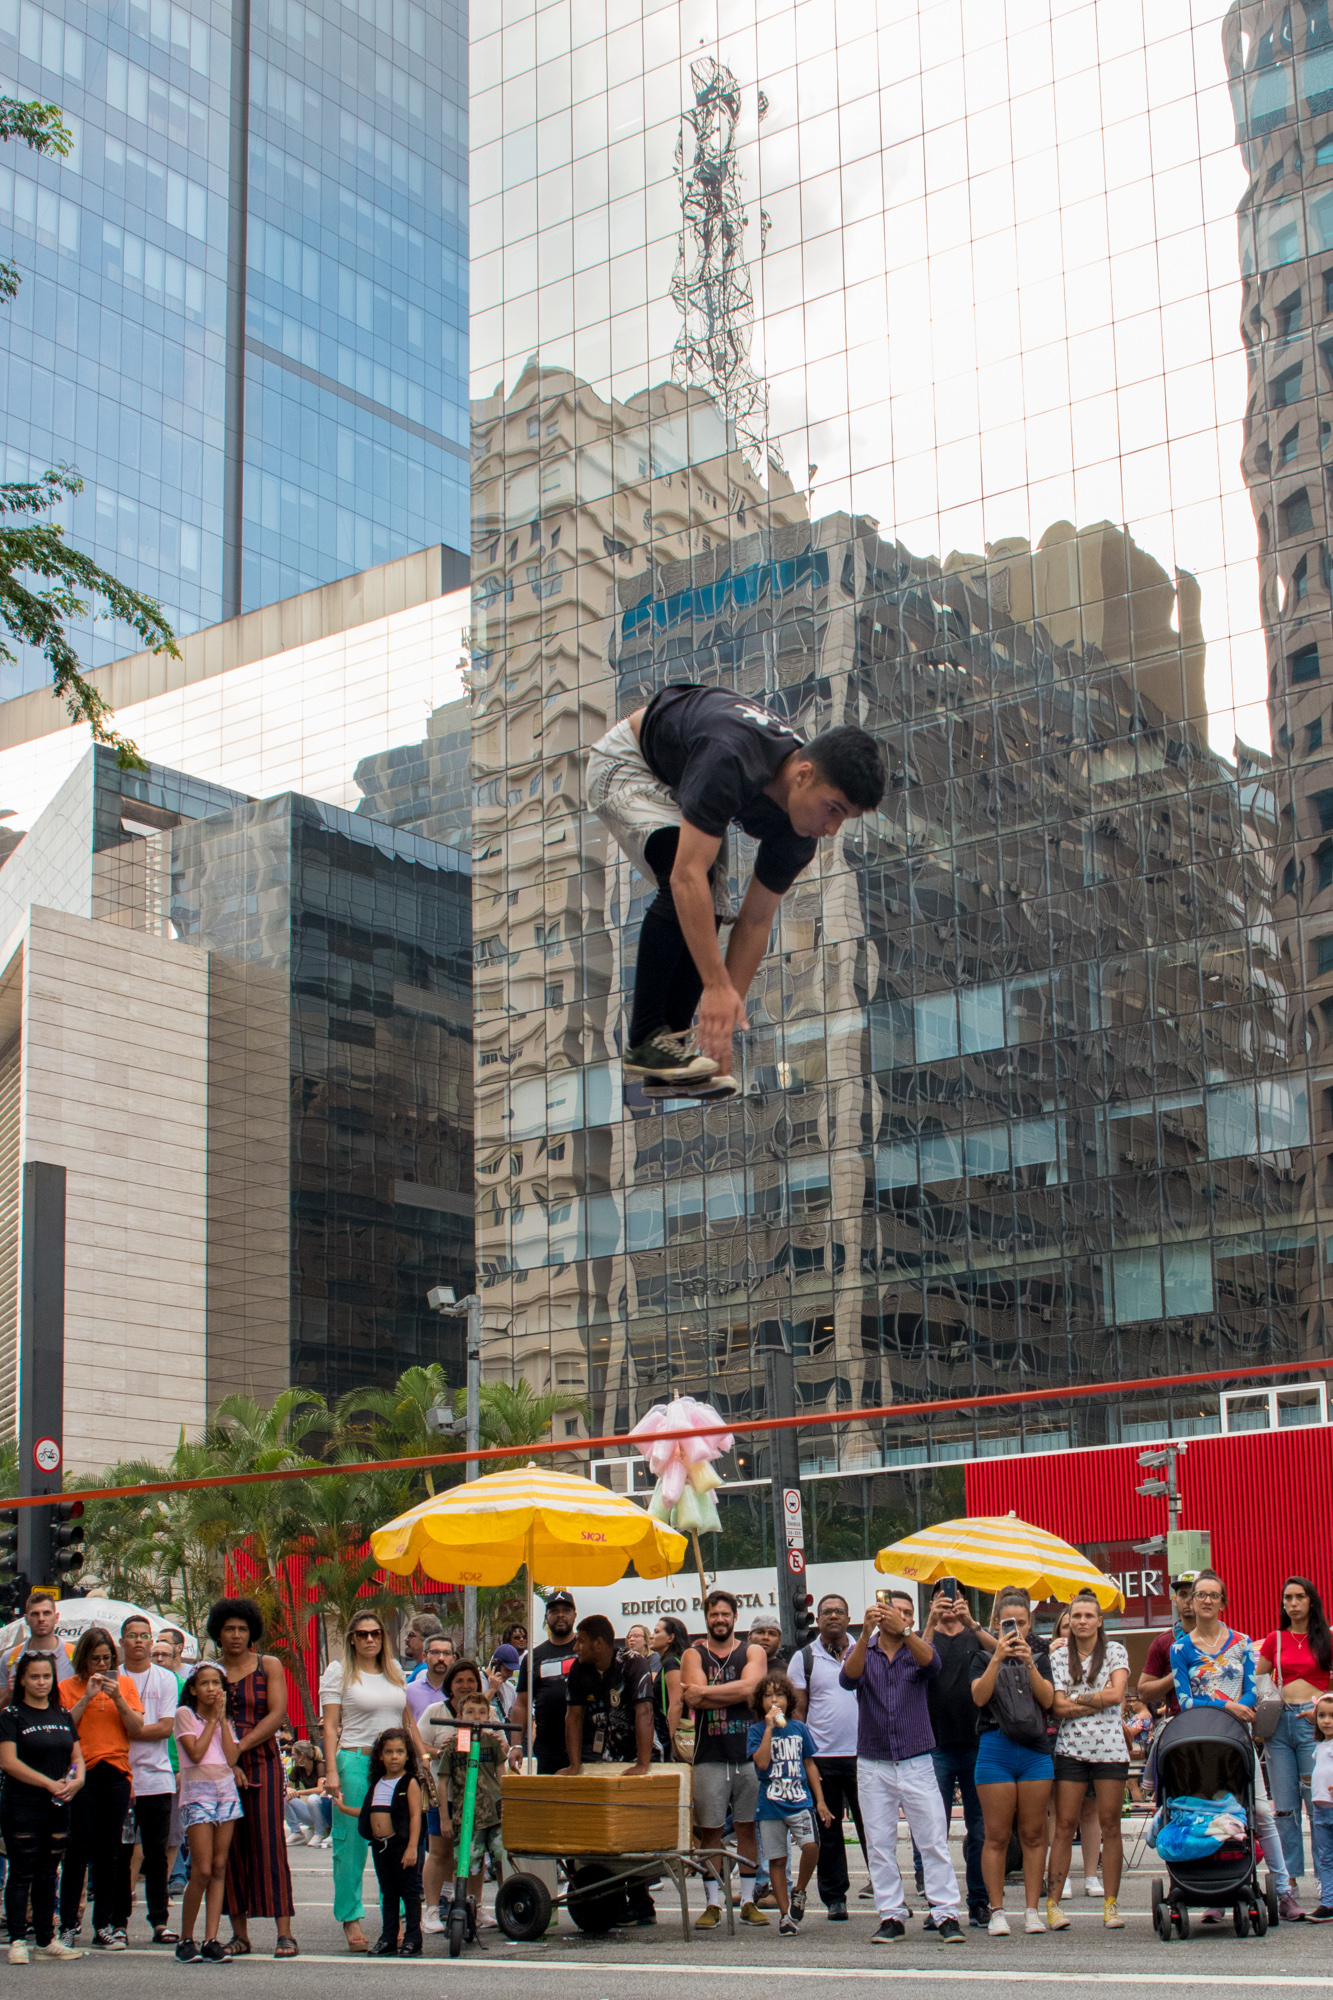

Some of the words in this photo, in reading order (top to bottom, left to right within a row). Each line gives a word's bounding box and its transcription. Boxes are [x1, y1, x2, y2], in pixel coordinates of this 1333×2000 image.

[581, 1531, 607, 1543] SKOL
[621, 1596, 687, 1615] EDIFÍCIO
[771, 1735, 803, 1762] COME
[769, 1762, 784, 1777] AT
[788, 1761, 802, 1777] ME
